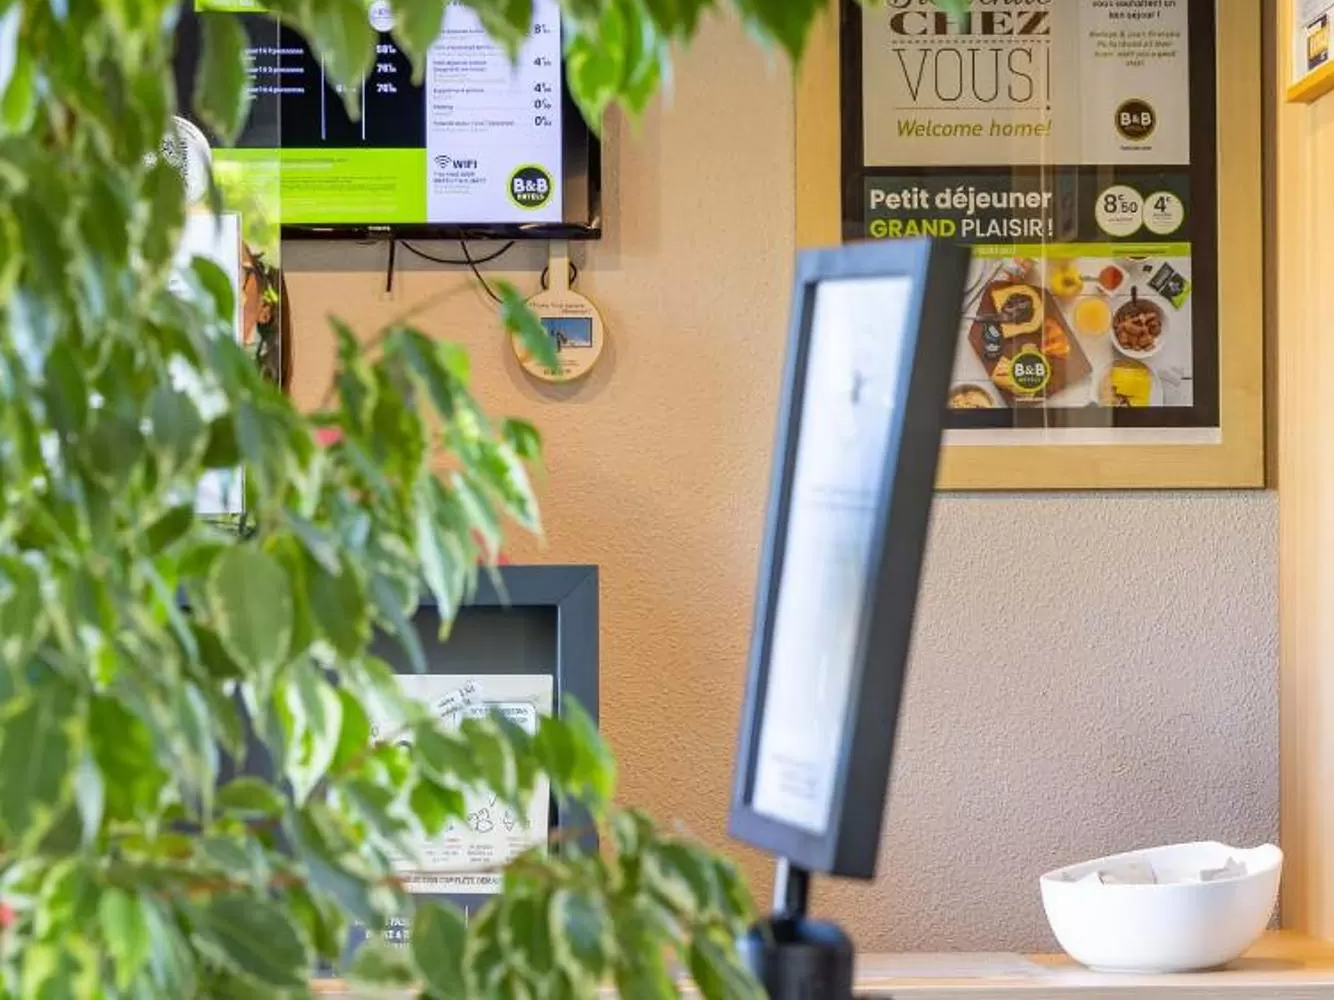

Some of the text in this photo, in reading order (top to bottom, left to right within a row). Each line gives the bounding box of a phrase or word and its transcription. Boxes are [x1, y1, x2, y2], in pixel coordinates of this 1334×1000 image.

[889, 10, 1051, 36] CHEZ
[896, 118, 1053, 138] Welcome home!
[452, 159, 478, 170] WIFI
[513, 177, 549, 194] B&B
[869, 185, 1053, 215] Petit déjeuner
[869, 218, 957, 239] GRAND
[960, 218, 1043, 238] PLAISIR
[1014, 362, 1046, 378] B&B
